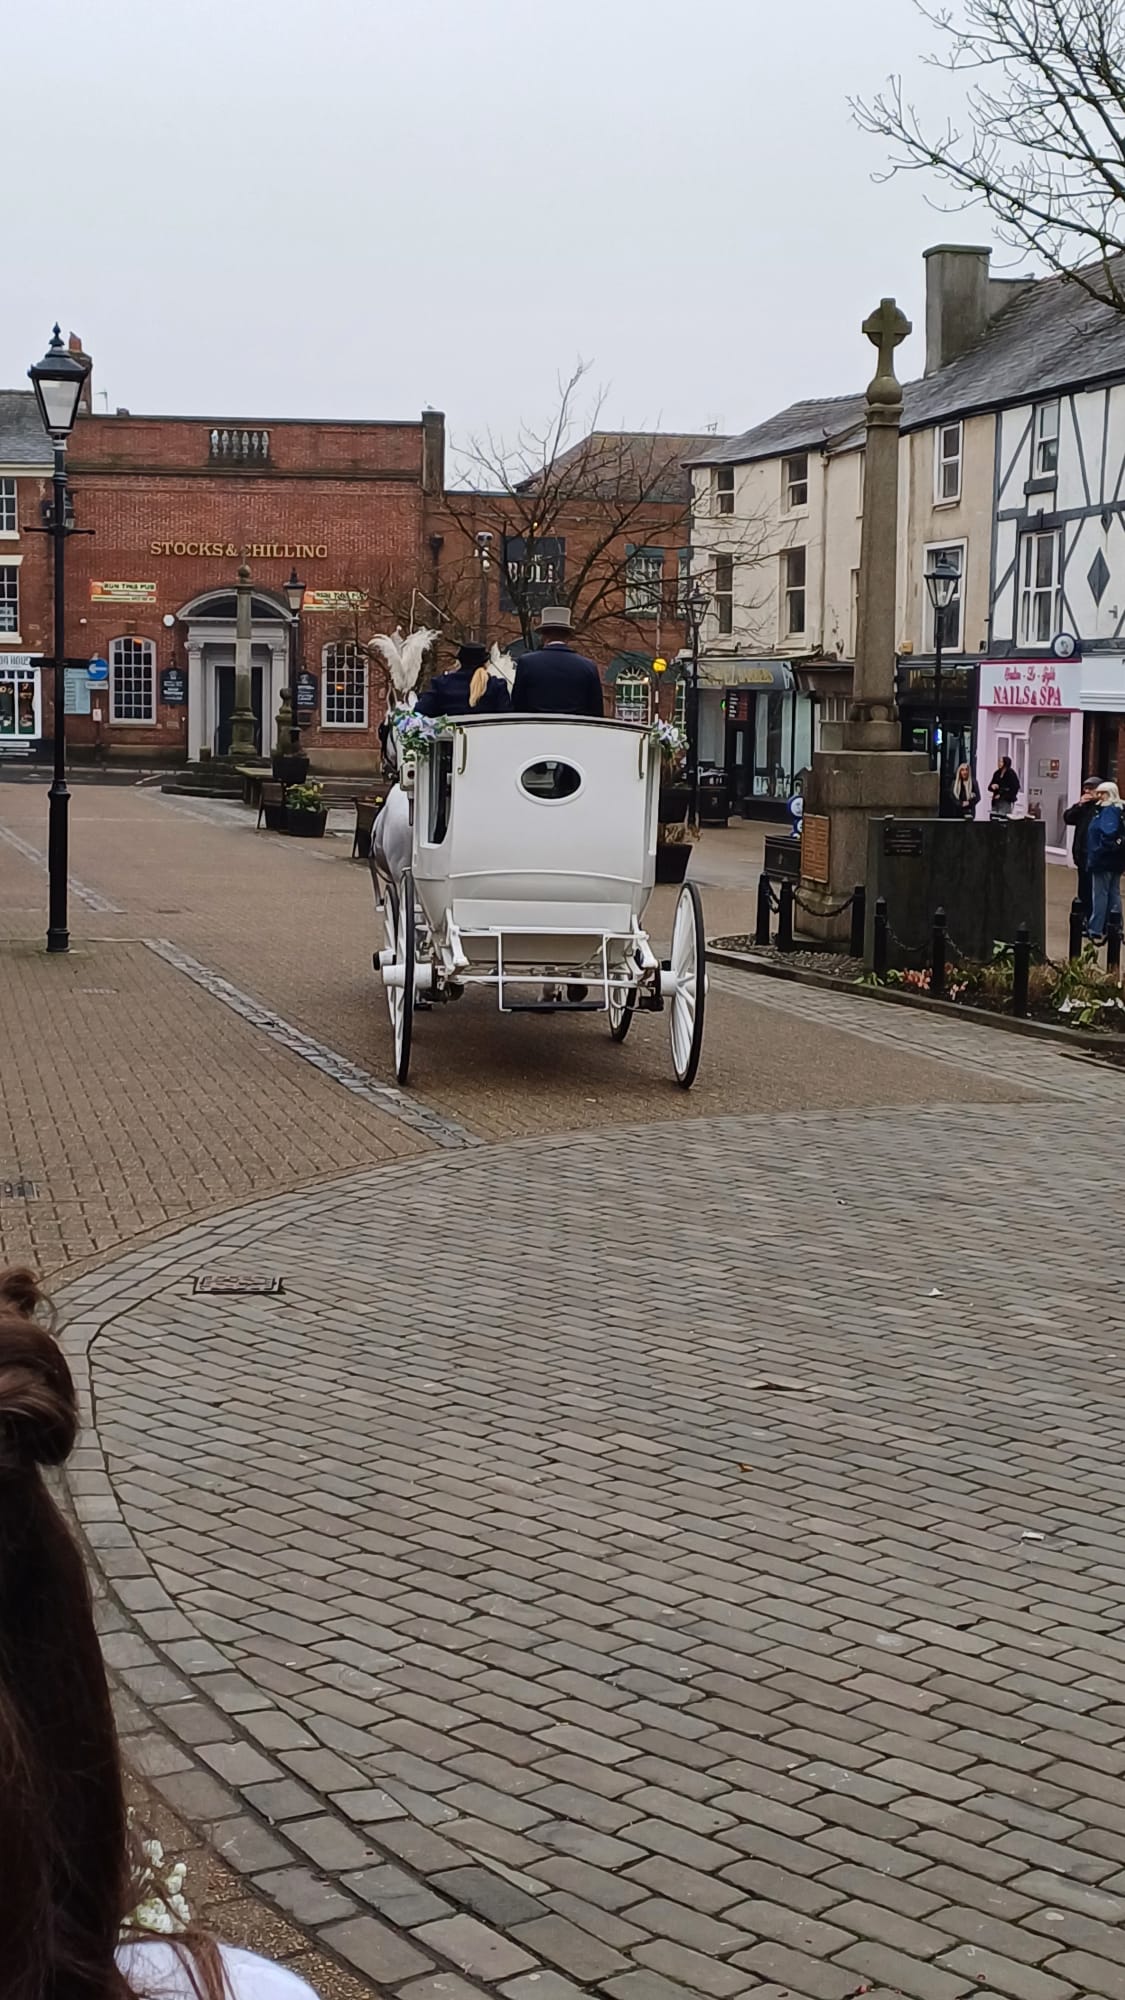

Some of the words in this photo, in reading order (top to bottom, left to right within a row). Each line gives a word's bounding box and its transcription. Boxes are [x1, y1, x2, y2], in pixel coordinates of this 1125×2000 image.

[150, 541, 223, 556] STOCKS
[225, 542, 238, 557] &
[993, 686, 1030, 704] NAILS
[1040, 686, 1062, 706] SPA
